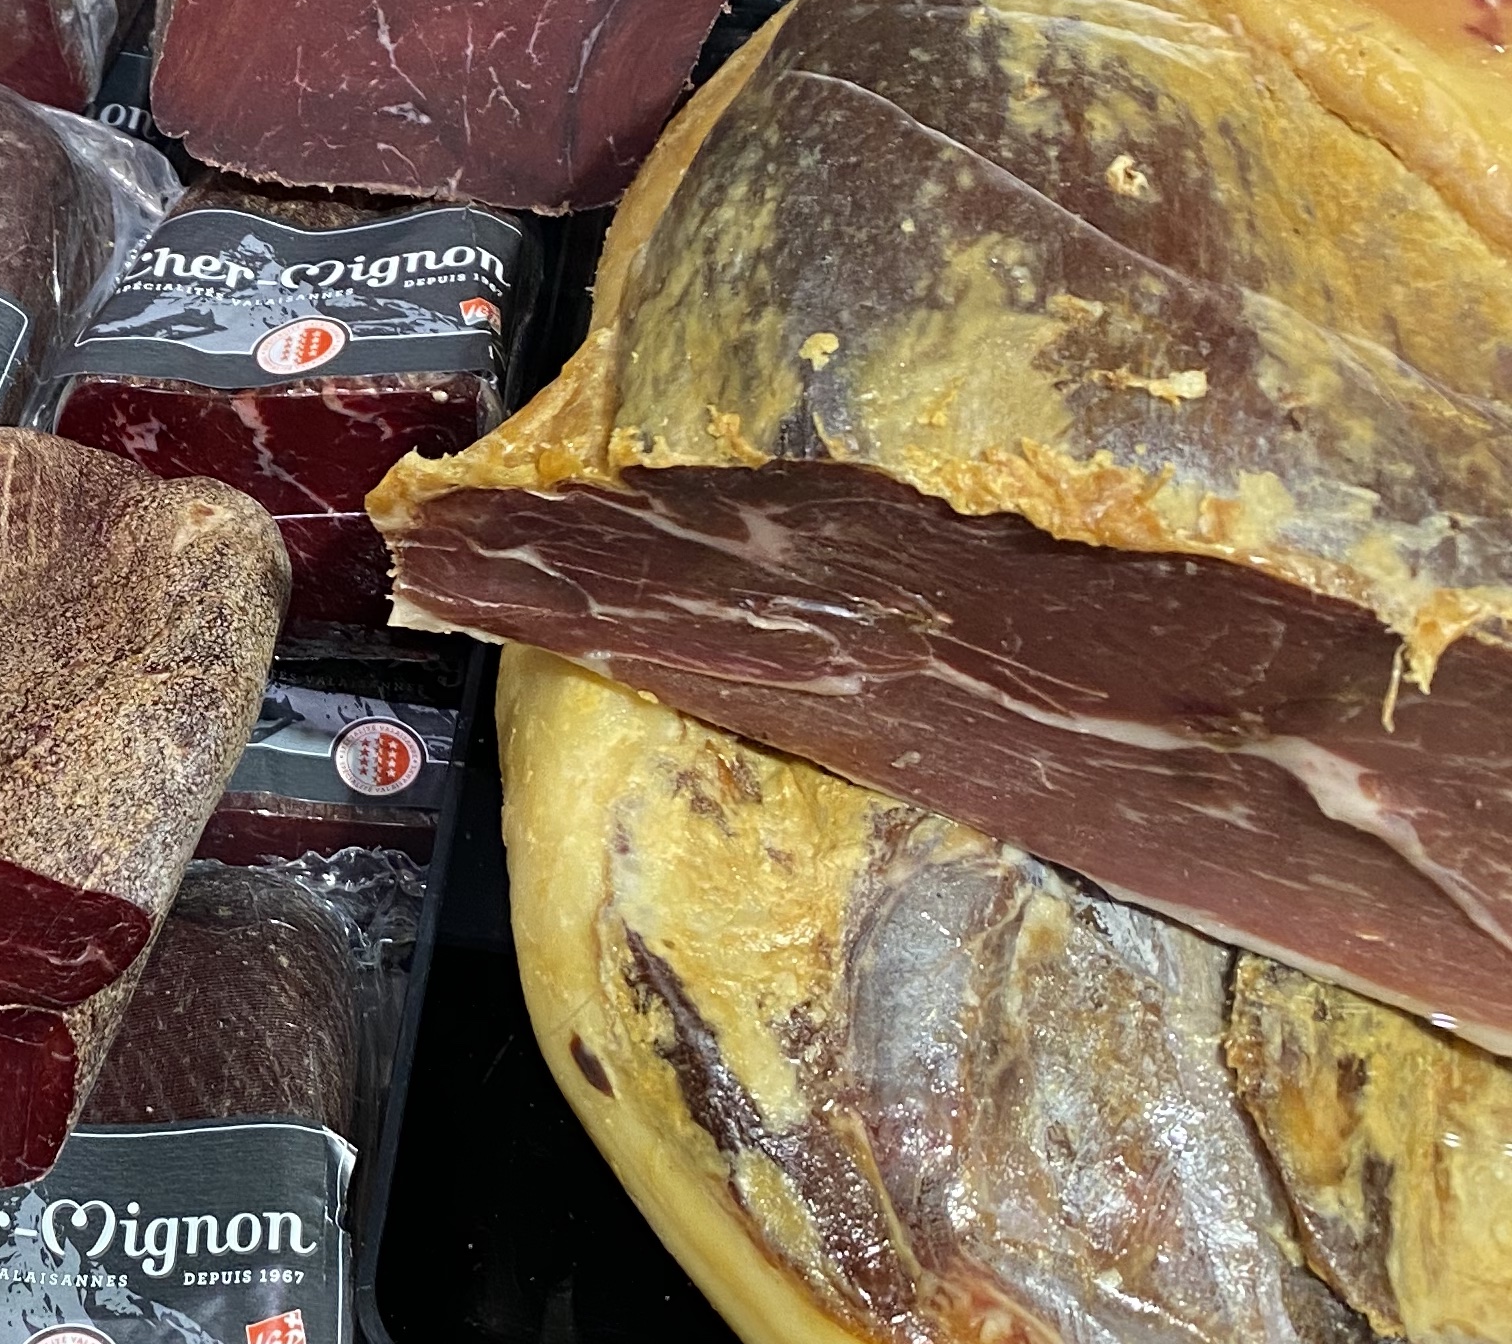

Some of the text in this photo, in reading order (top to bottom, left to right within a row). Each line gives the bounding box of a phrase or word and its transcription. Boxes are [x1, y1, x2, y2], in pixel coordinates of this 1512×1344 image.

[403, 273, 467, 288] DEPUIS
[232, 287, 355, 308] VALAISANNES
[182, 1268, 305, 1287] DEPUIS 1967
